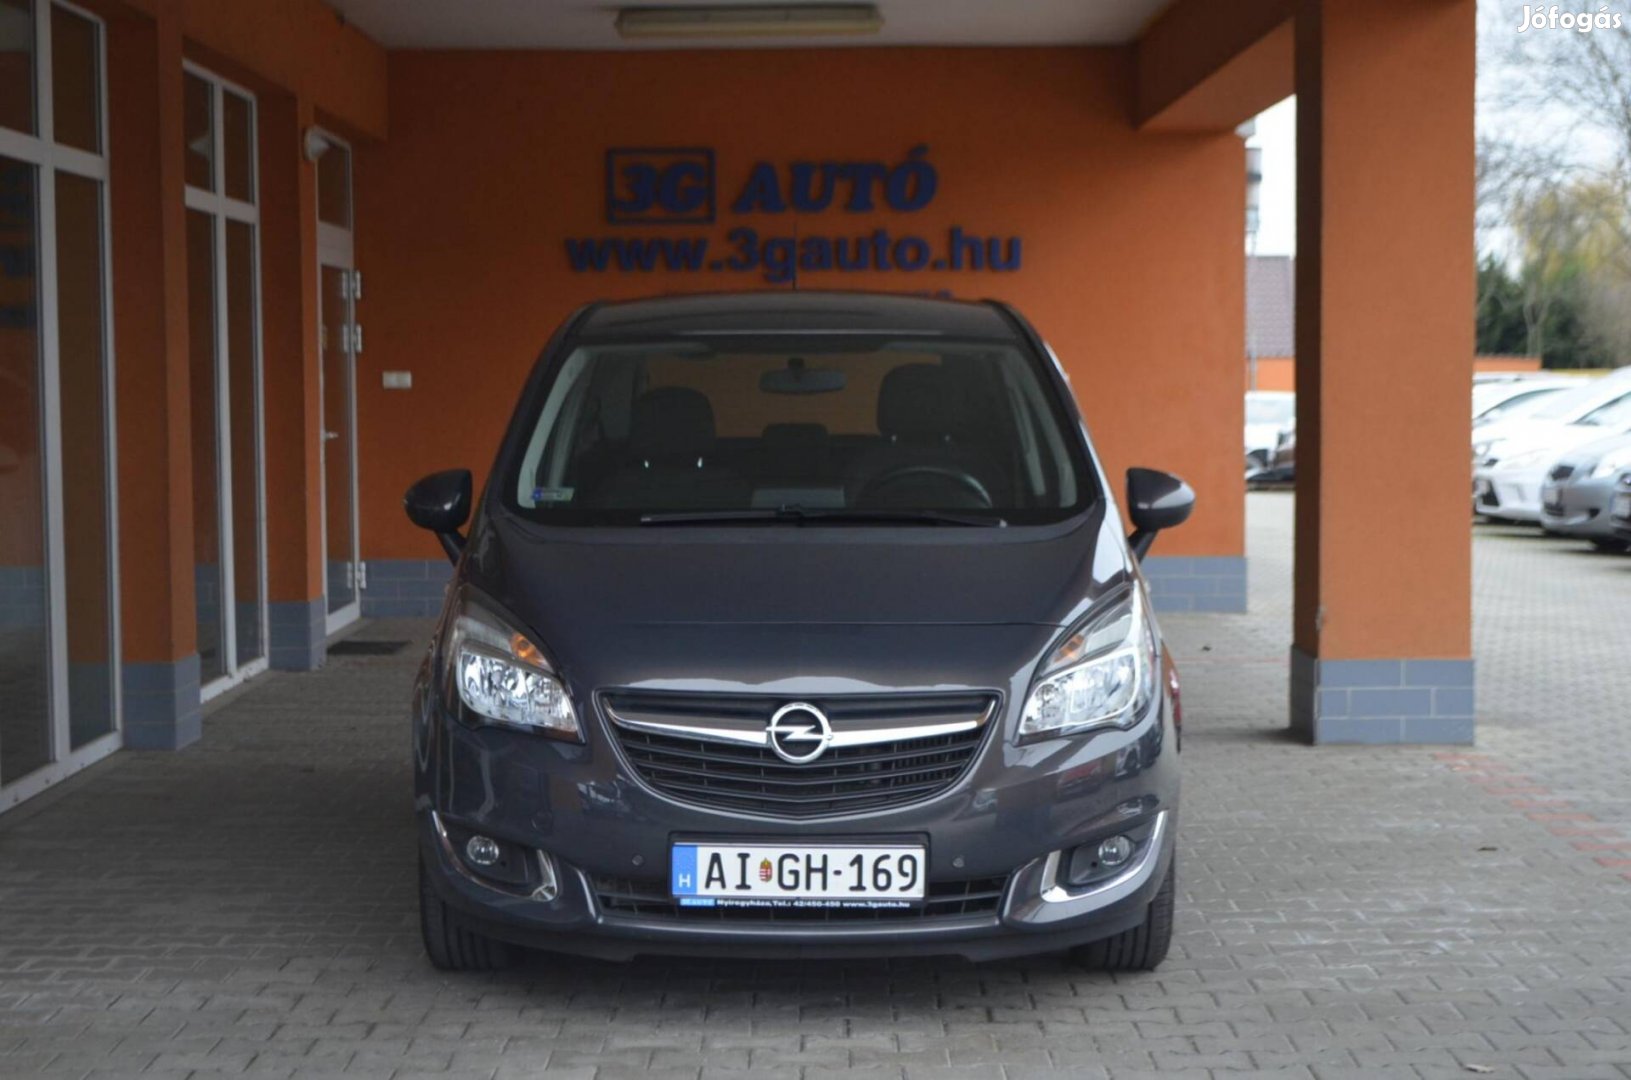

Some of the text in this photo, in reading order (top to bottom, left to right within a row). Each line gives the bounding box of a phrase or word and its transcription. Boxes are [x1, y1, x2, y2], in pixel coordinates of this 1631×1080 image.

[610, 144, 938, 215] 3G AUTÓ
[565, 227, 1023, 283] www.3gauto.hu
[678, 873, 691, 888] H
[704, 852, 918, 892] AI GH-169
